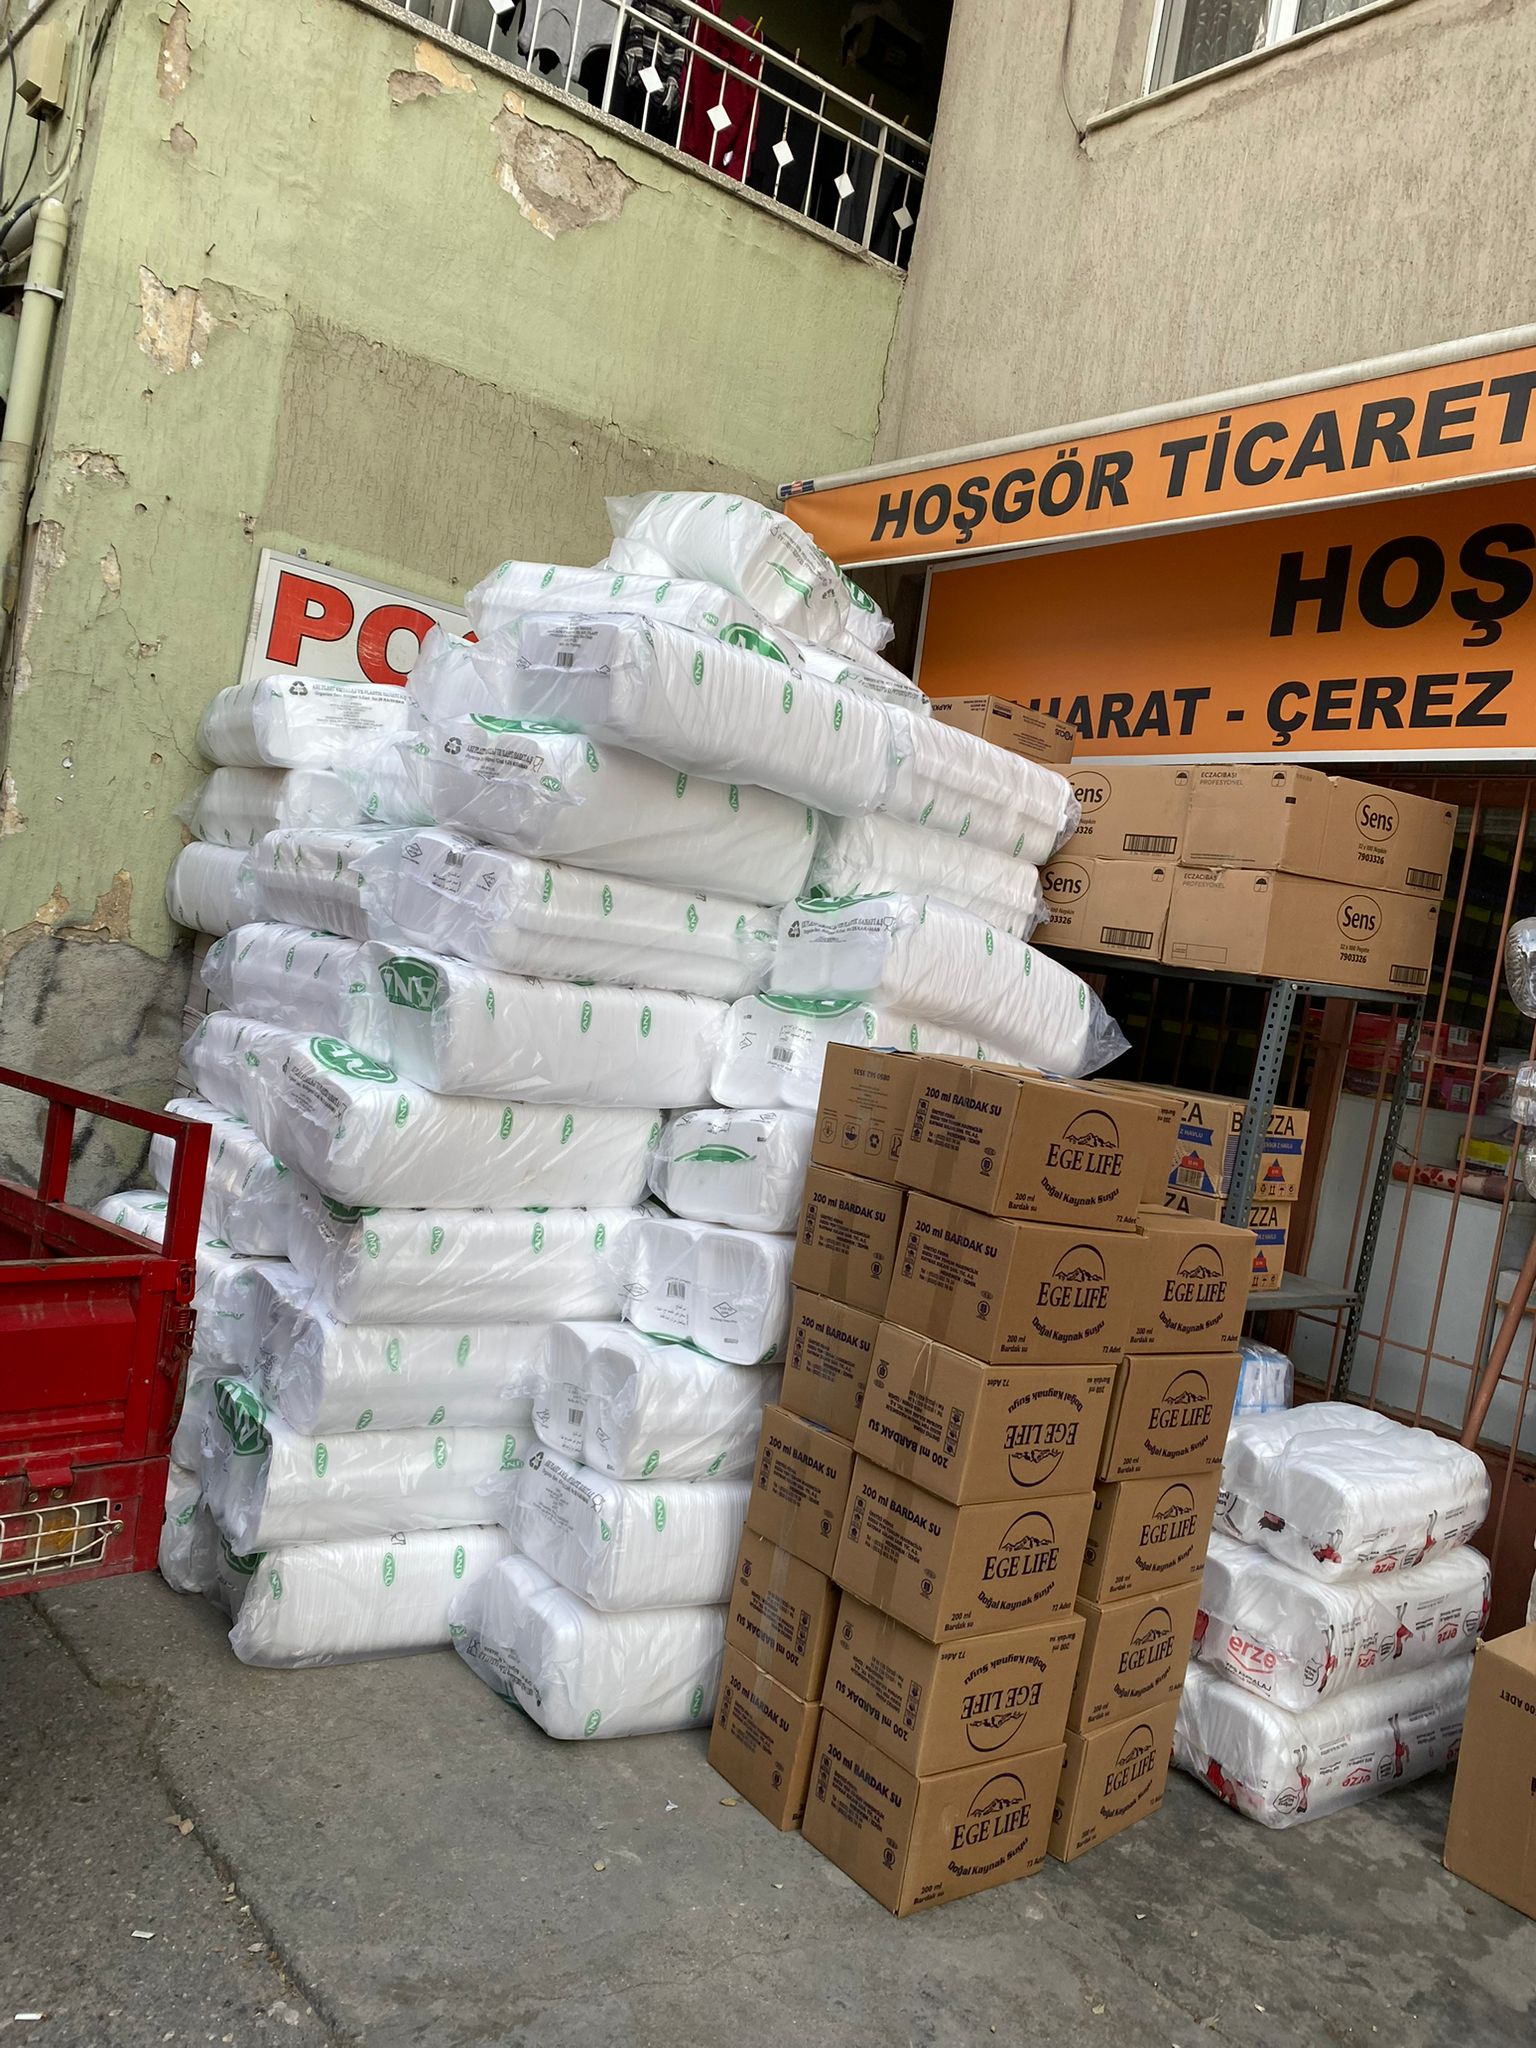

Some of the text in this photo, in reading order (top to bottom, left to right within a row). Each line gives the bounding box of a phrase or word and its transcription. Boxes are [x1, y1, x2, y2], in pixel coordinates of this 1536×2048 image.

[871, 370, 1536, 544] HOŞGÖR TİCARET
[1269, 522, 1536, 648] HOŞ
[265, 570, 478, 688] PO
[1266, 670, 1514, 746] ÇEREZ
[1360, 804, 1394, 832] Sens
[1357, 852, 1385, 865] 7903326
[1042, 870, 1082, 894] Sens
[1342, 905, 1376, 931] Sens
[1339, 952, 1367, 963] 7903326
[380, 961, 441, 1010] ANI
[925, 1086, 1002, 1117] 200 ml BARDAK SU
[1045, 1143, 1123, 1176] EGE LIFE
[1041, 1176, 1063, 1199] Doğal
[1063, 1193, 1096, 1207] Kaynak
[813, 1192, 886, 1223] 200 ml BARDAK SU
[915, 1220, 998, 1259] 200 ml BARDAK SU
[1036, 1282, 1109, 1309] EGE LIFE
[1163, 1280, 1227, 1302] EGE LIFE
[801, 1316, 814, 1329] 200
[858, 1339, 870, 1352] SU
[1032, 1316, 1052, 1337] Doğal
[1052, 1331, 1083, 1343] Kaynak
[1148, 1405, 1213, 1429] EGE LIFE
[868, 1418, 949, 1468] 200 ml BARDAK SU
[1004, 1422, 1079, 1449] EGE LIFE
[769, 1435, 837, 1479] 200 ml BARDAK SU
[862, 1484, 941, 1537] 200 ml BARDAK SU
[1139, 1515, 1197, 1546] EGE LIFE
[982, 1548, 1059, 1580] EGE LIFE
[978, 1591, 999, 1609] Doğal
[1000, 1596, 1032, 1611] Kaynak
[736, 1613, 745, 1623] SU
[786, 1650, 799, 1666] 200
[990, 1654, 1025, 1669] Kaynak
[1025, 1656, 1047, 1673] Doğal
[1118, 1636, 1175, 1674] EGE LIFE
[1229, 1636, 1276, 1669] erze
[835, 1680, 908, 1741] 200 ml BARDAK SU
[960, 1682, 1043, 1720] EGE LIFE
[1499, 1689, 1523, 1709] ADET
[779, 1718, 789, 1732] SU
[827, 1743, 902, 1808] 200 ml BARDAK SU
[1103, 1749, 1156, 1797] EGE LIFE
[951, 1804, 1031, 1851] EGE LIFE
